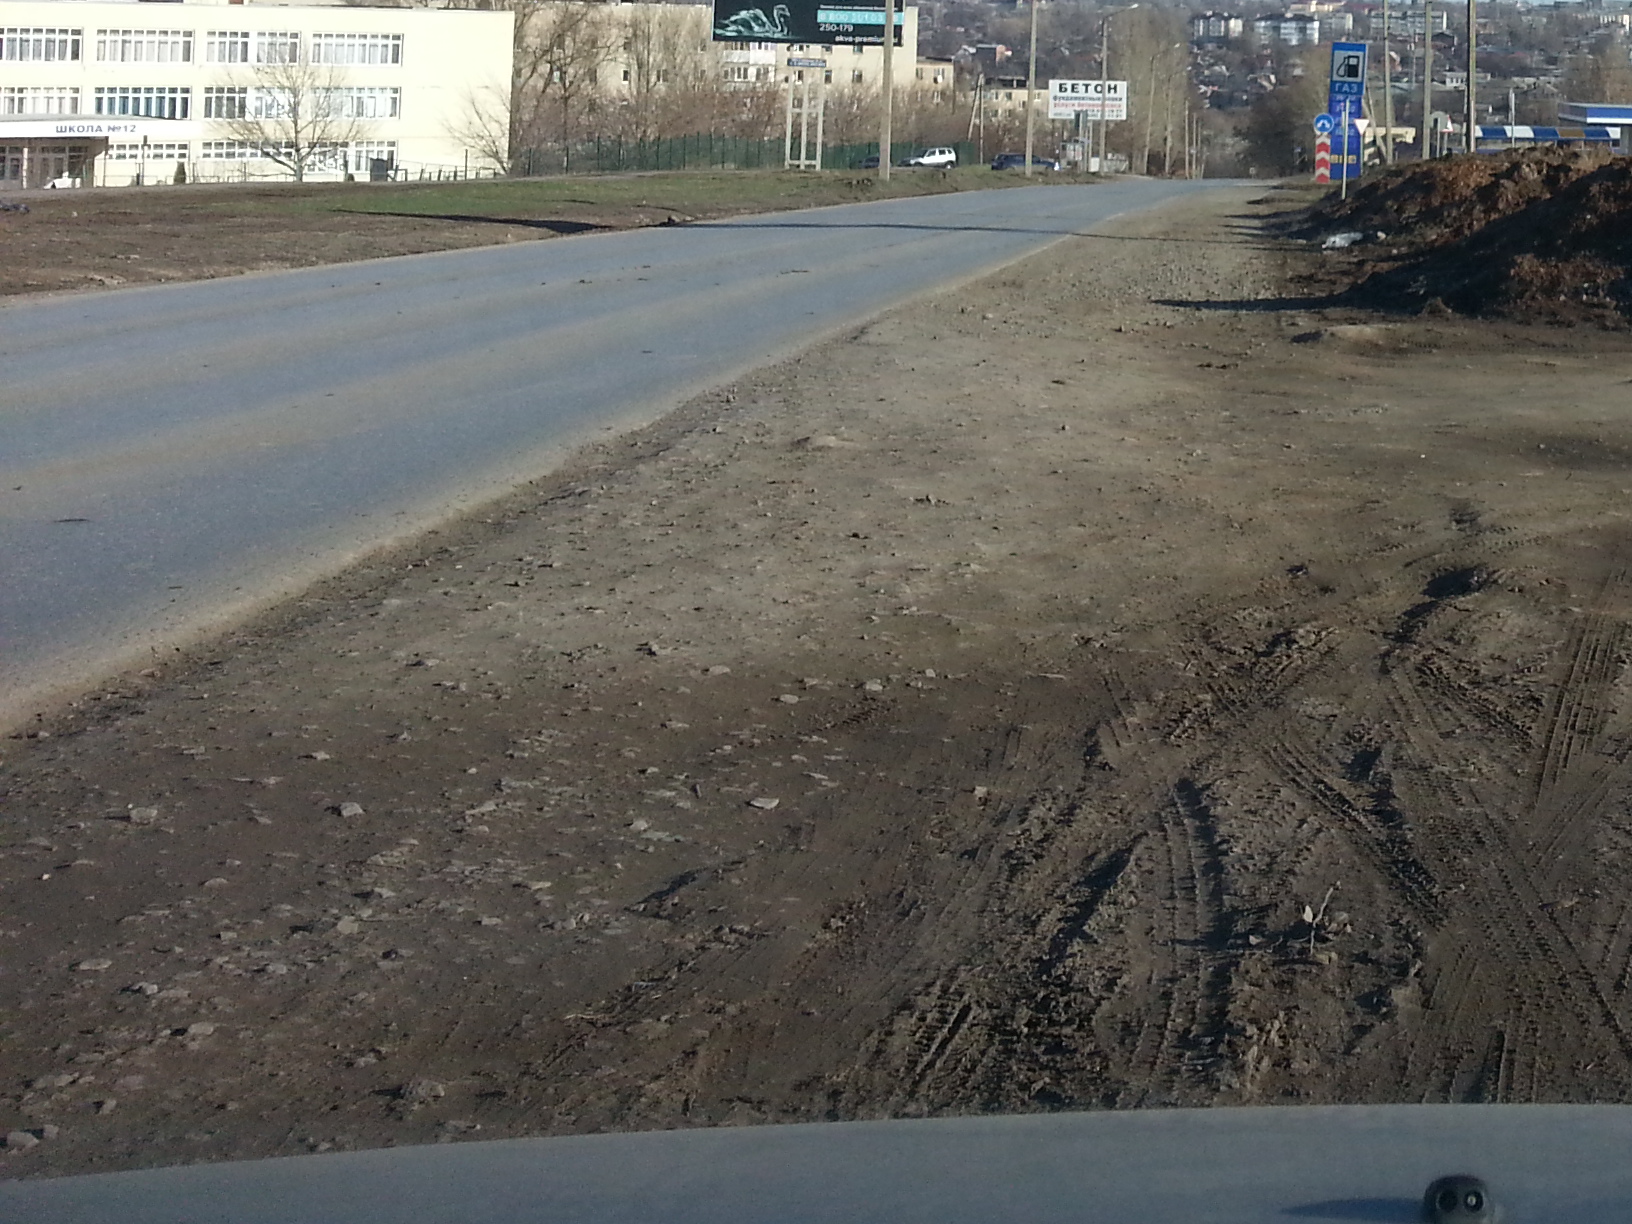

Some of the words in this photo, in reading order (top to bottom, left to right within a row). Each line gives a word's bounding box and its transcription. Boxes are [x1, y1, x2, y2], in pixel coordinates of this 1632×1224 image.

[1058, 83, 1117, 94] БЕТОН
[1335, 83, 1358, 93] ГАЗ
[56, 124, 103, 133] ШКОЛА
[107, 124, 137, 133] №12
